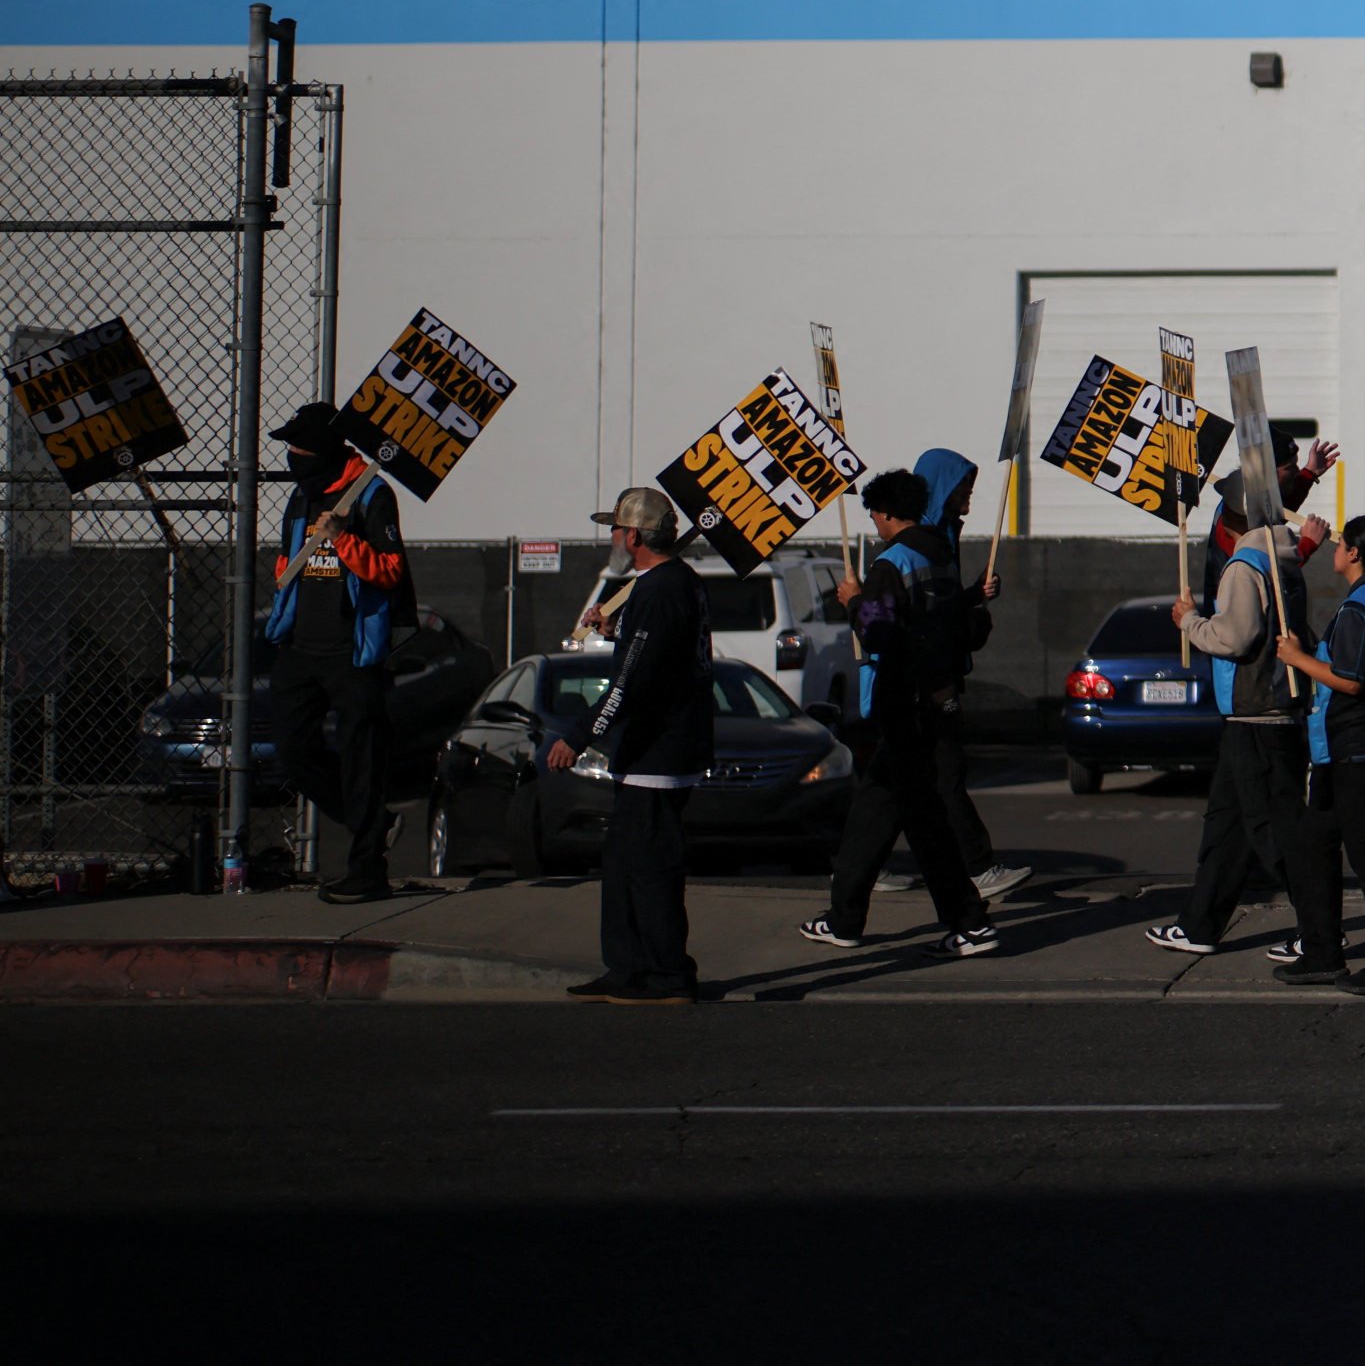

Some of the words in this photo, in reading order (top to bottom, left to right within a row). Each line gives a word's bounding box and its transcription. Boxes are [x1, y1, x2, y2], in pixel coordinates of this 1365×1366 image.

[9, 323, 124, 381] TANNC
[23, 339, 141, 412] AMAZON
[396, 332, 498, 420] AMAZON
[419, 311, 510, 393] TANNC
[1160, 330, 1194, 361] TANNC
[30, 369, 151, 434] ULP
[45, 391, 176, 469] STRIKE
[352, 376, 465, 479] STRIKE
[378, 351, 480, 438] ULP
[770, 372, 860, 476] TANNC
[1044, 362, 1110, 458] TANNC
[1067, 369, 1142, 477] AMAZON
[1161, 389, 1196, 428] ULP
[719, 409, 816, 519] ULP
[742, 392, 843, 503] AMAZON
[1093, 384, 1162, 492] ULP
[1162, 420, 1198, 475] STRIKE
[684, 432, 798, 559] STRIKE
[306, 555, 339, 568] MAZO
[600, 687, 624, 717] LOCAL
